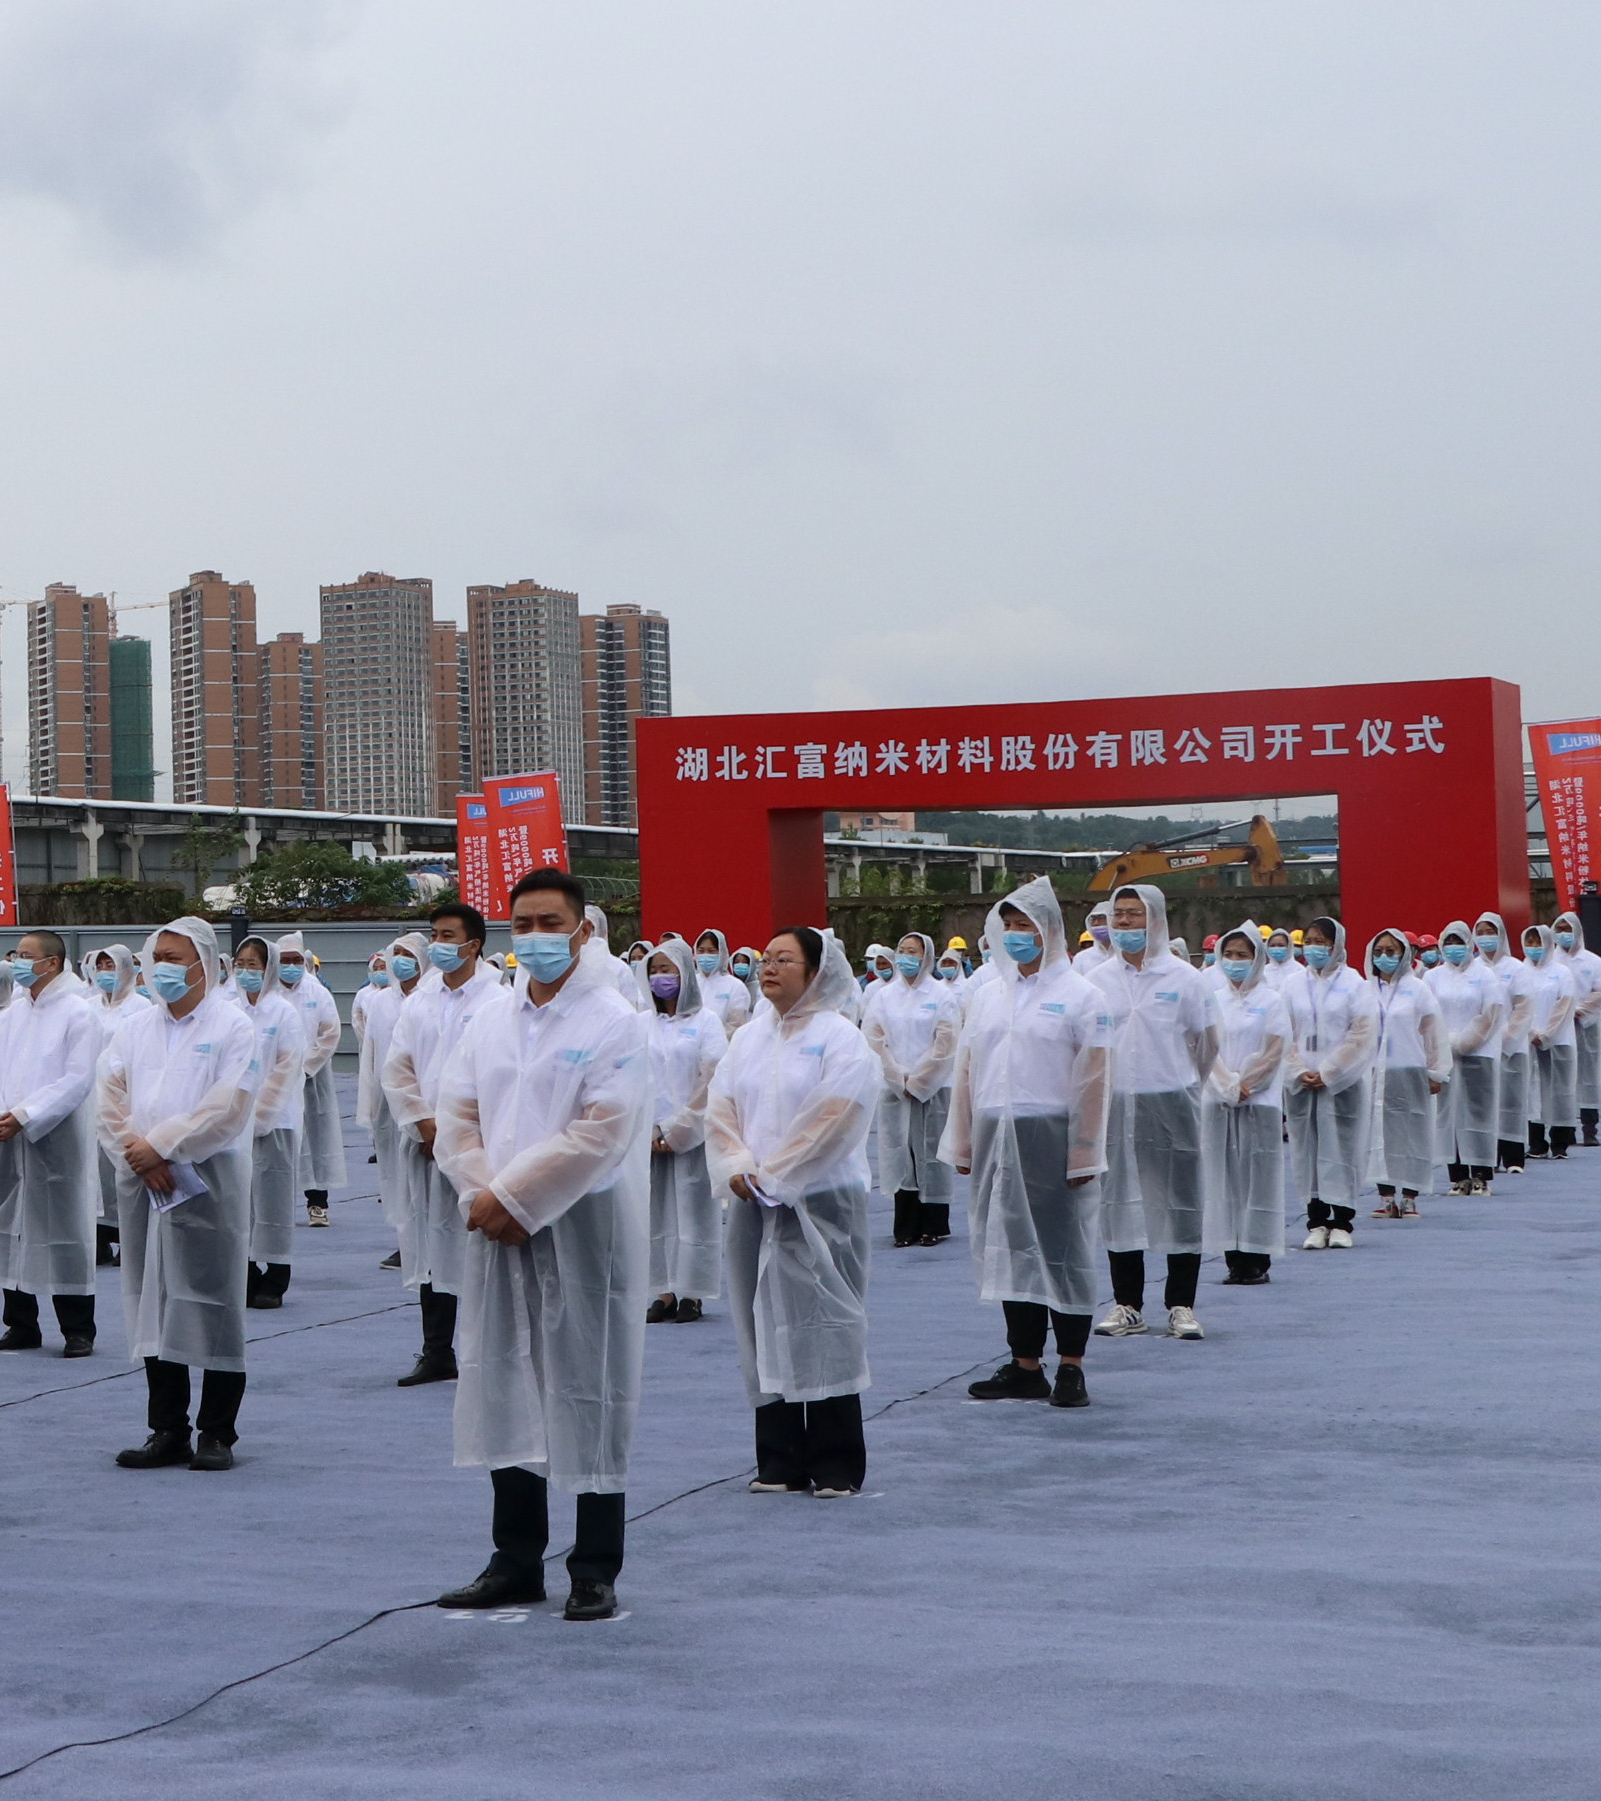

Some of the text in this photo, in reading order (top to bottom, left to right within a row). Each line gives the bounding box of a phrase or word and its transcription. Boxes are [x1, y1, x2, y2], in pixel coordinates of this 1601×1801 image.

[674, 714, 1446, 782] 湖北汇富纳米材料股份有限公司开工仪式
